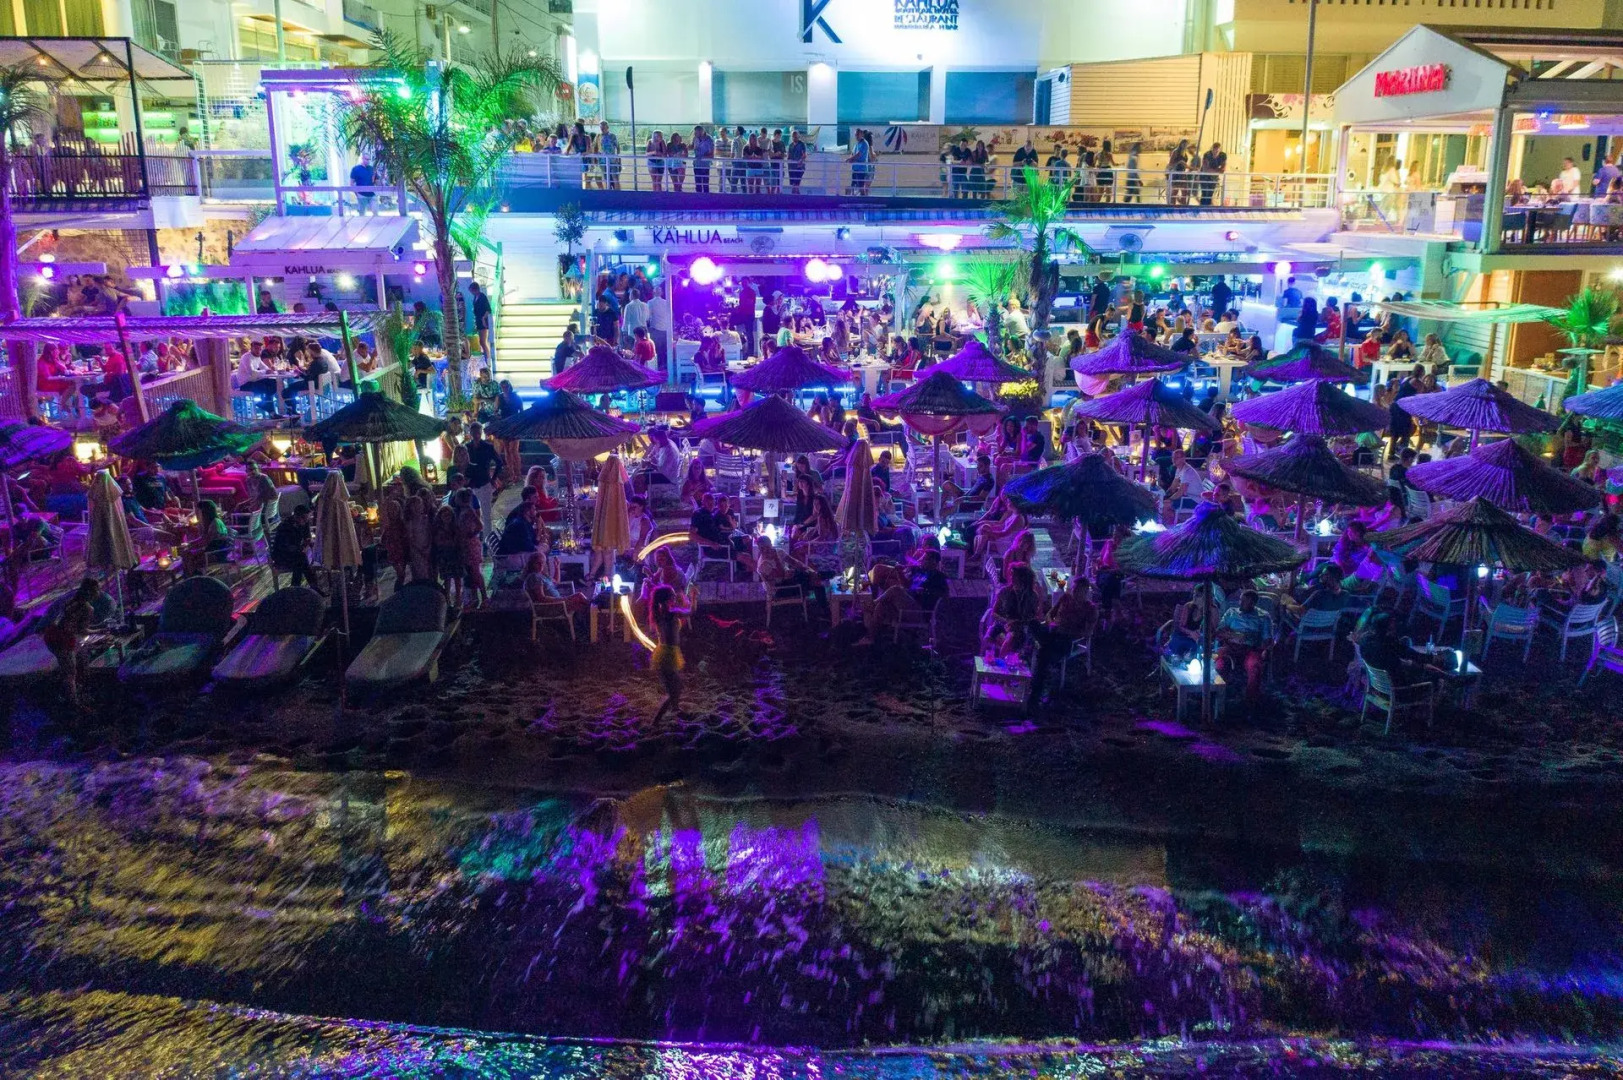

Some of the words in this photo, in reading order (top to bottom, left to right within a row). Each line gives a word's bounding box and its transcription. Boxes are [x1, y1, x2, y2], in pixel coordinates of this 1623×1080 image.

[895, 0, 959, 9] KAHLUA
[652, 229, 722, 244] KAHLUA
[285, 266, 325, 274] KAHLUA
